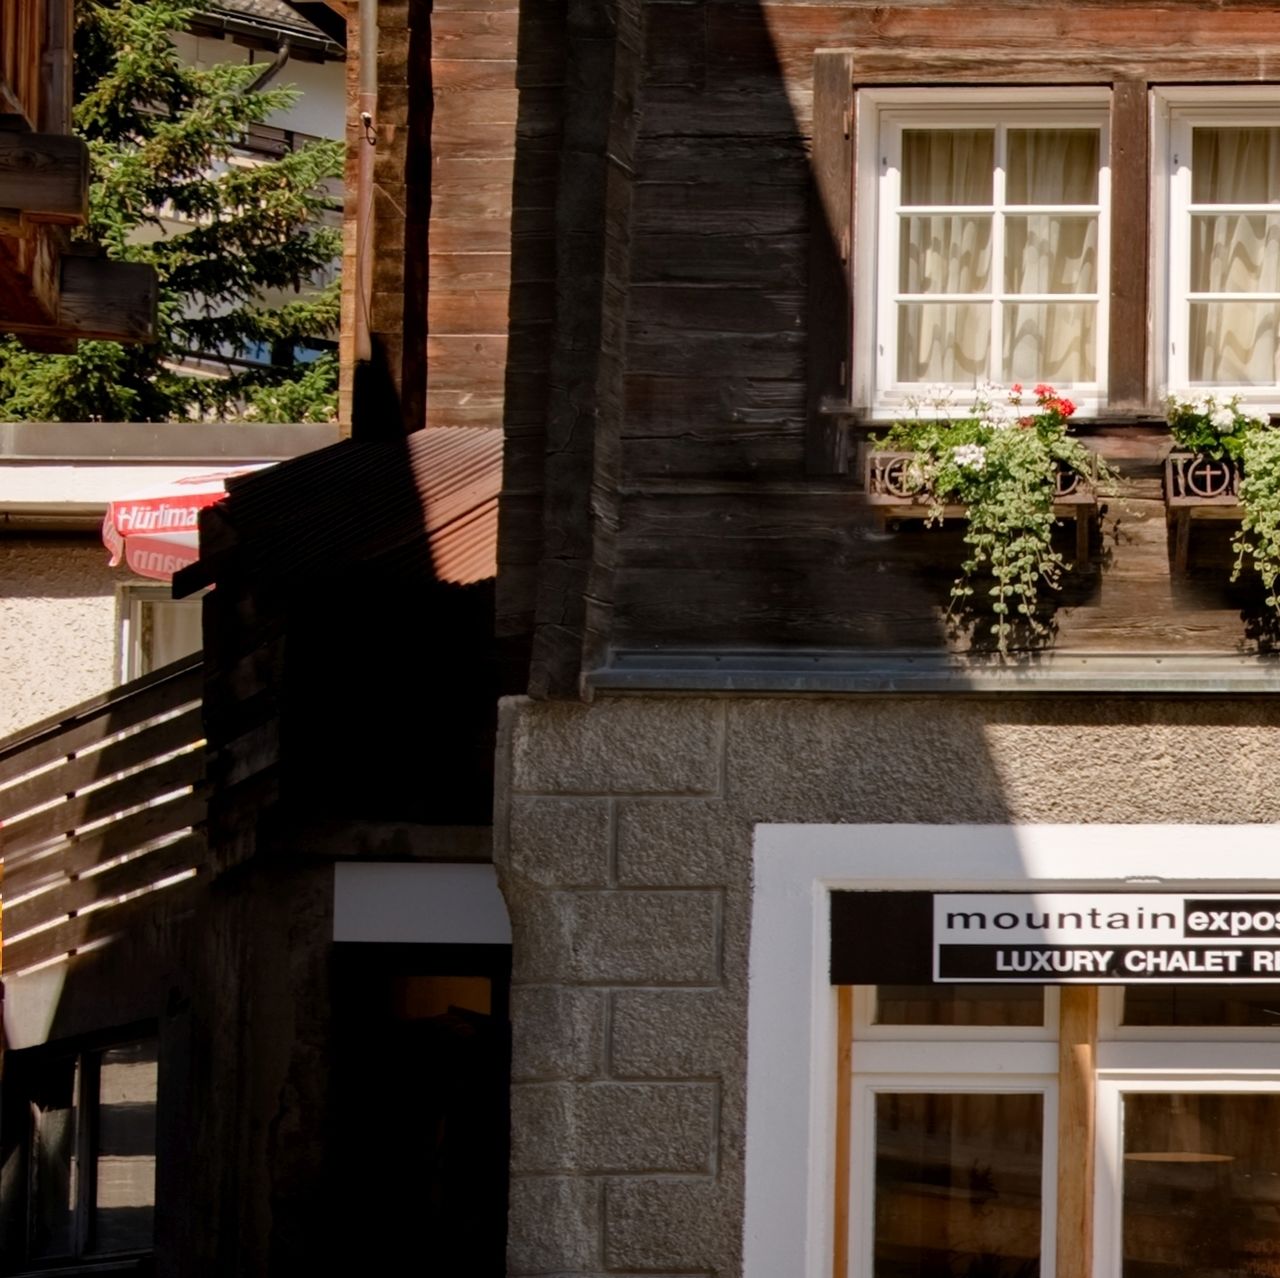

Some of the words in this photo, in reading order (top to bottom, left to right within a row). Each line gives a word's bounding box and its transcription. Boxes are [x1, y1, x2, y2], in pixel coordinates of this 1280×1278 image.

[117, 505, 200, 531] Hürlima
[946, 907, 1177, 930] mountain
[995, 951, 1113, 973] LUXURY
[1124, 951, 1242, 973] CHALET
